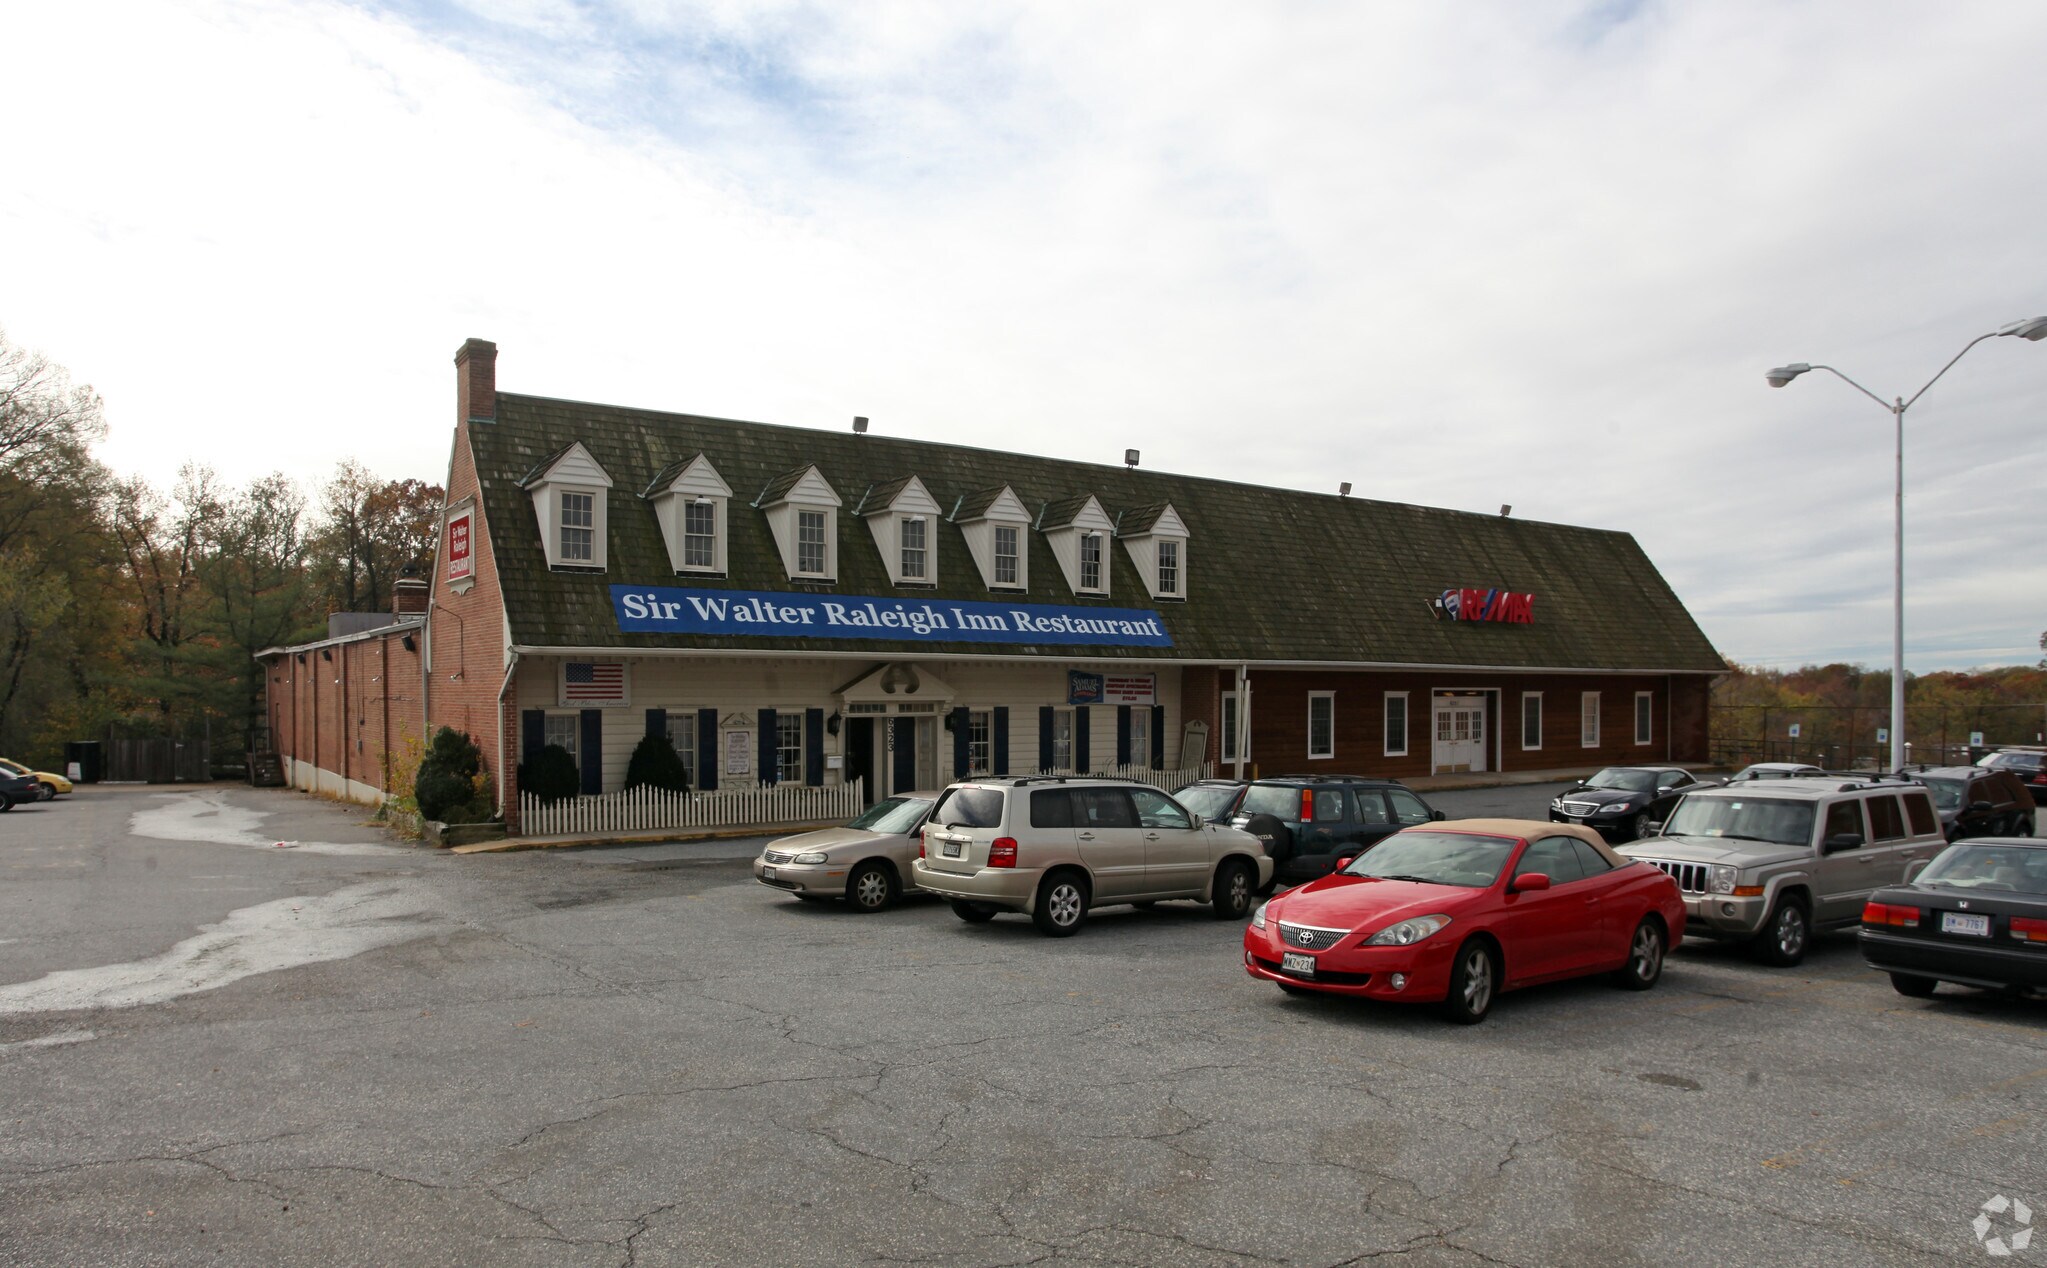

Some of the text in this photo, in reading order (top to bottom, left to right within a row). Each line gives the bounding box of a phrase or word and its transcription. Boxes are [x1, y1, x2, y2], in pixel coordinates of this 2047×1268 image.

[622, 593, 1162, 636] Sir Walter Raleigh Inn Restaurant
[1459, 588, 1535, 624] RE/MAX
